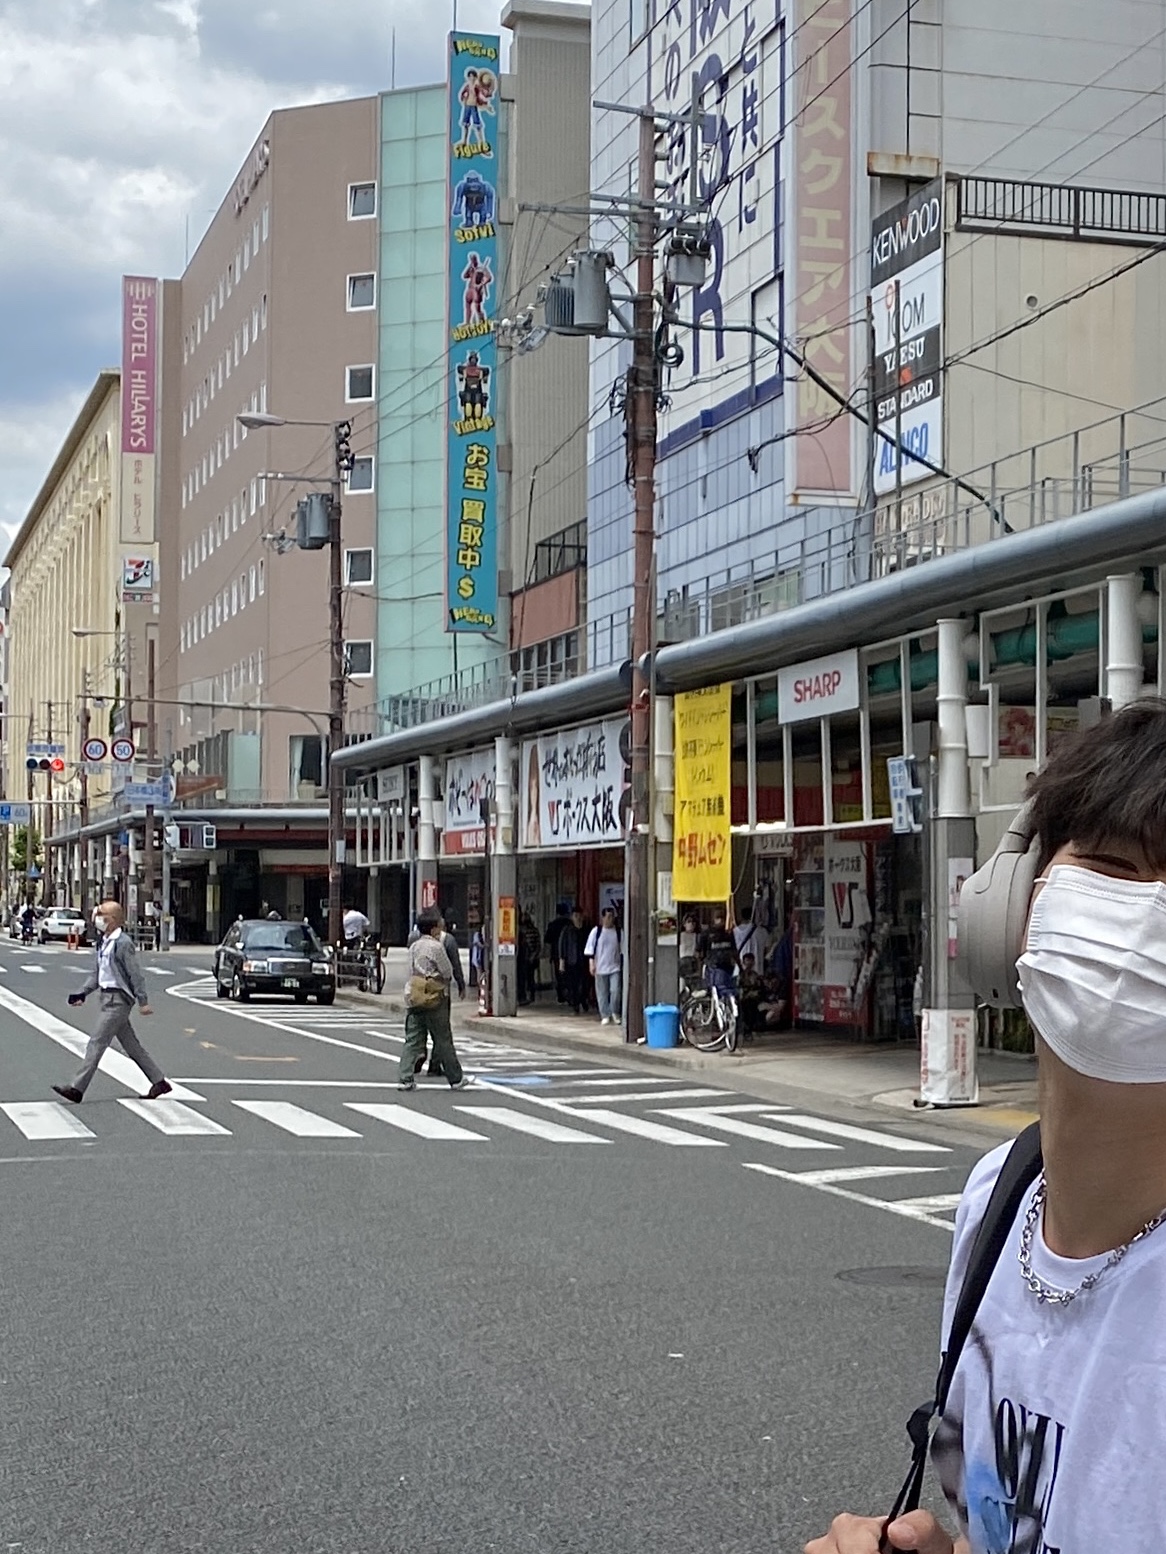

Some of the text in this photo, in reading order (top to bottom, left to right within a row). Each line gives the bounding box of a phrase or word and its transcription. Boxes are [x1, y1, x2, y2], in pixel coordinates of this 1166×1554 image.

[872, 198, 940, 269] KENWOOD
[130, 303, 148, 448] HOTEL HILLARYS
[465, 444, 489, 491] お宝
[880, 422, 929, 477] ALNCO
[458, 498, 485, 570] 買取中
[794, 670, 842, 703] SHARP
[88, 744, 103, 755] 60
[116, 744, 131, 756] 50
[678, 831, 726, 868] 中野ムセン
